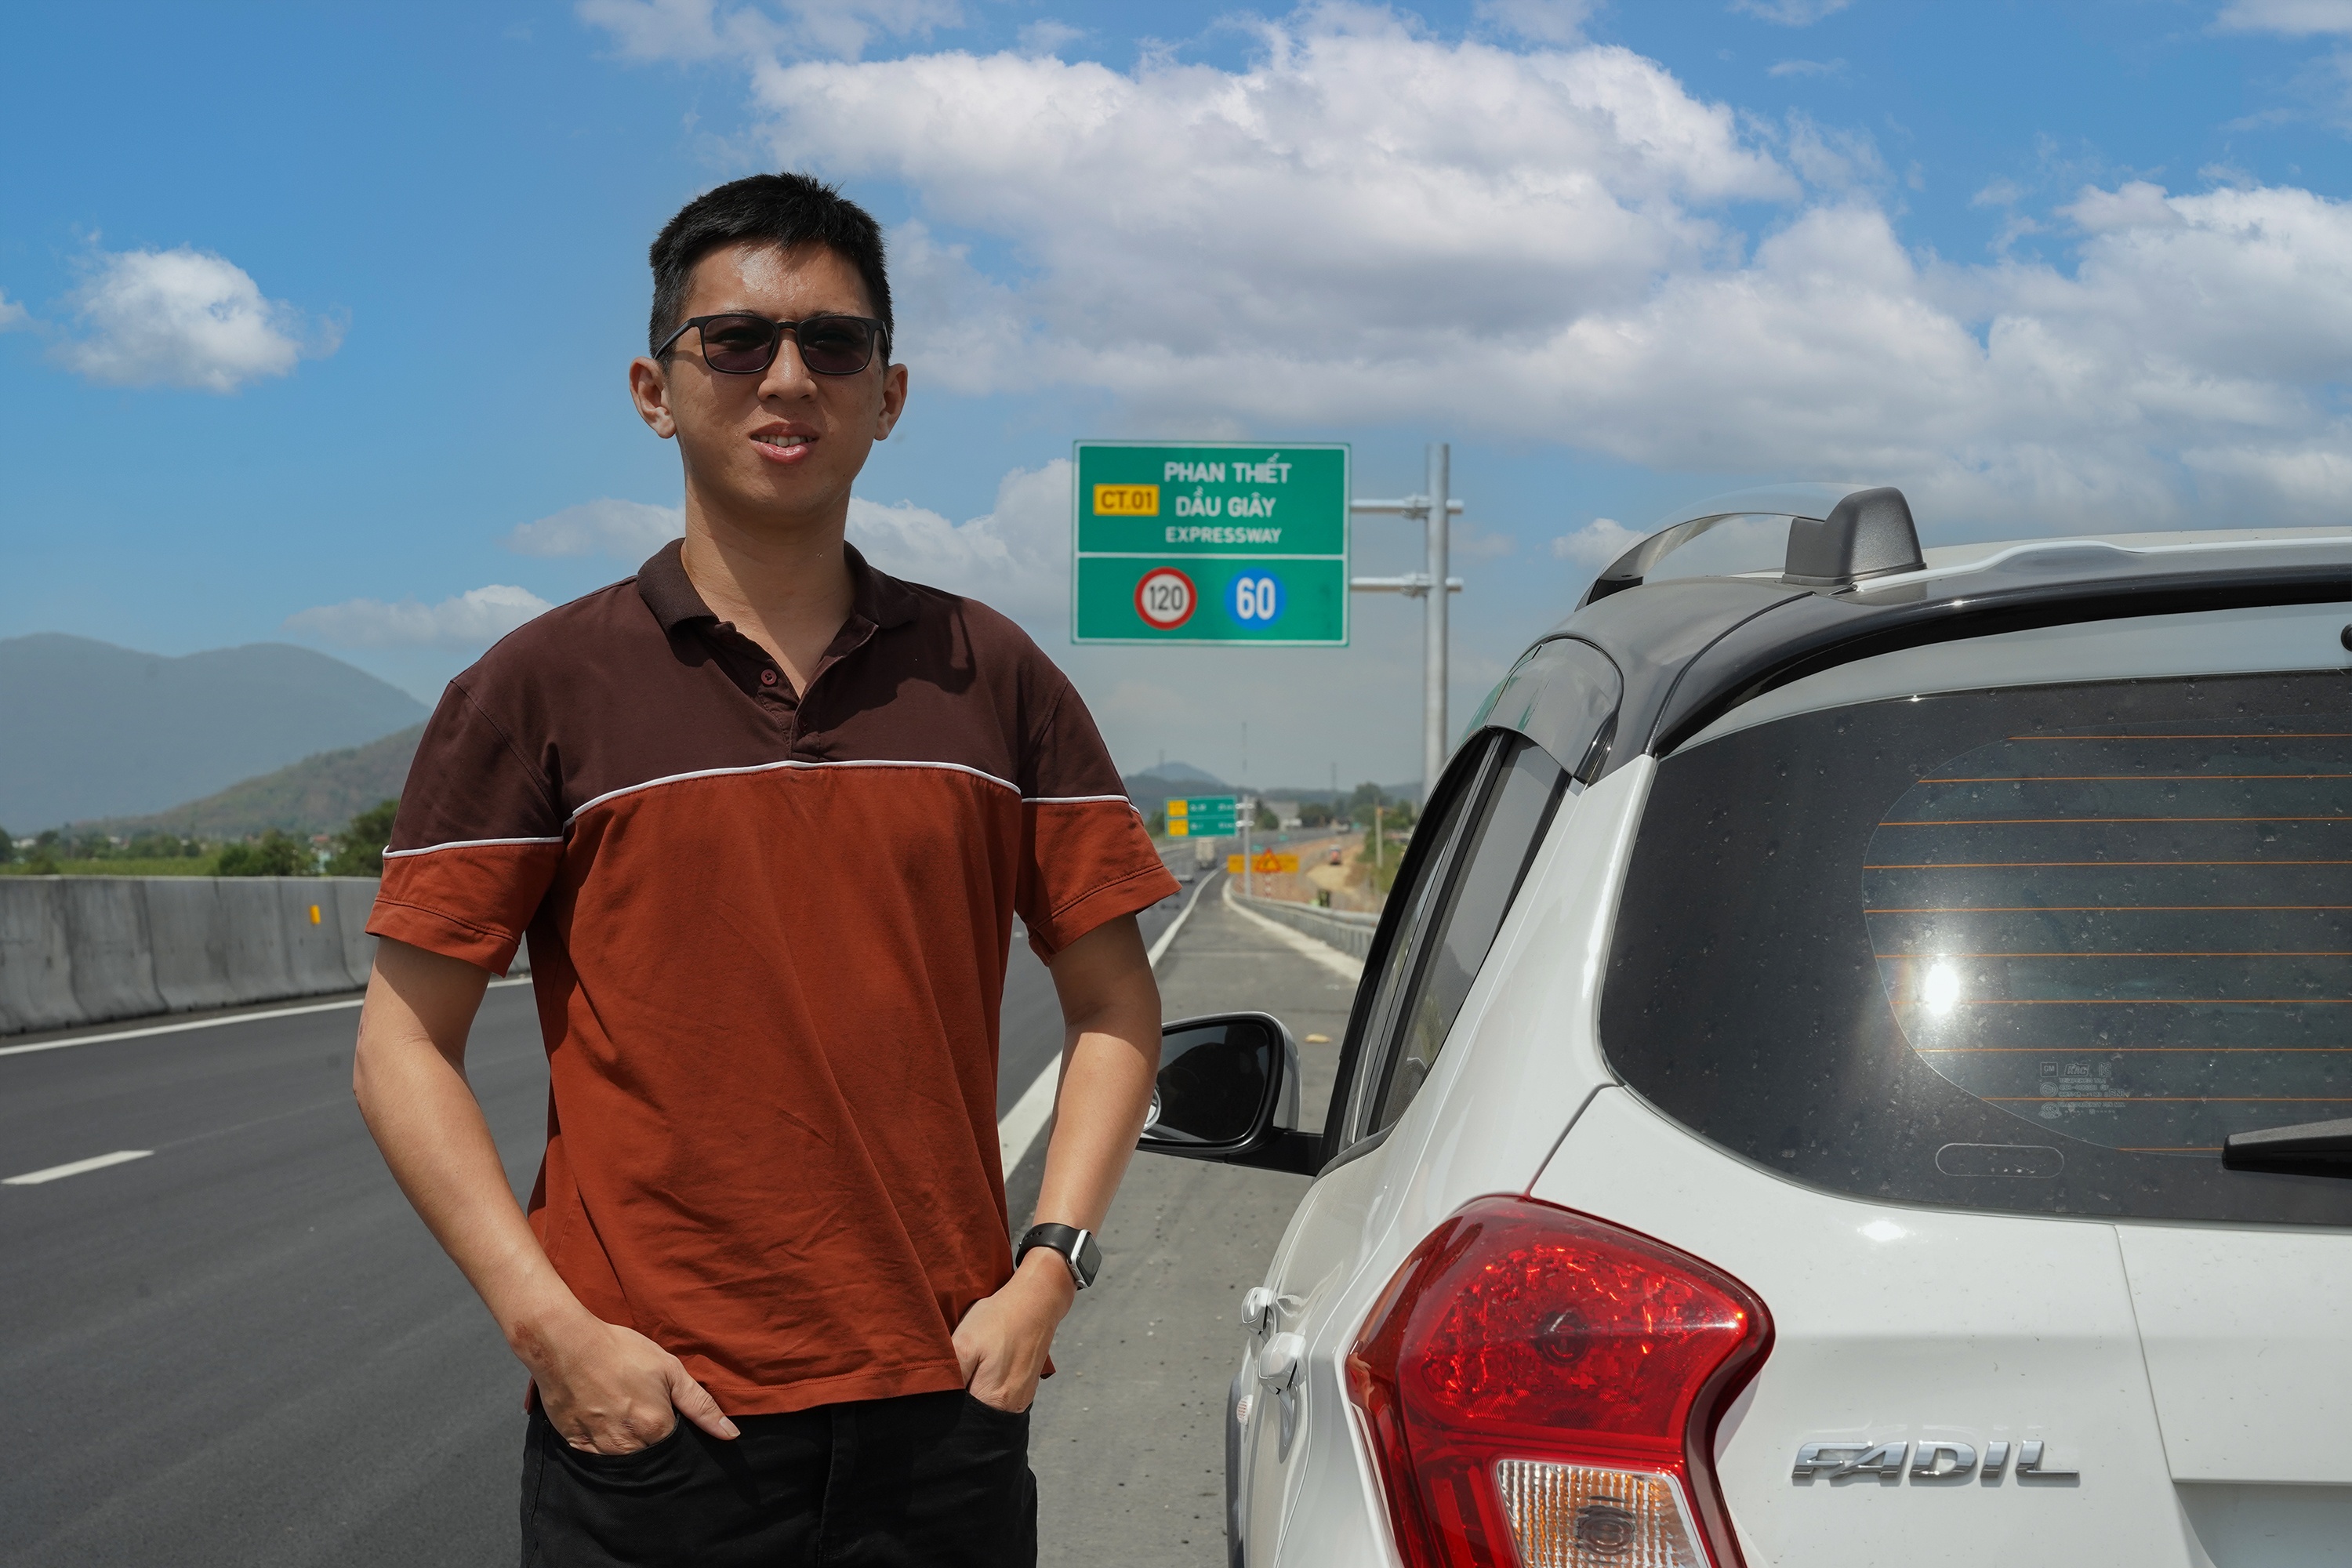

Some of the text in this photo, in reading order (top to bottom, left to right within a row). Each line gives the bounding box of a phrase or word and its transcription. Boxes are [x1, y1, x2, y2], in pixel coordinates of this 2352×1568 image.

[1164, 452, 1292, 484] PHAN THIẾT
[1102, 490, 1152, 510] CT.01
[1228, 492, 1276, 517] GIÂY
[1165, 526, 1282, 543] EXPRESSWAY
[1149, 586, 1183, 611] 120
[1236, 577, 1276, 620] 60
[1791, 1440, 2080, 1480] FADIL
